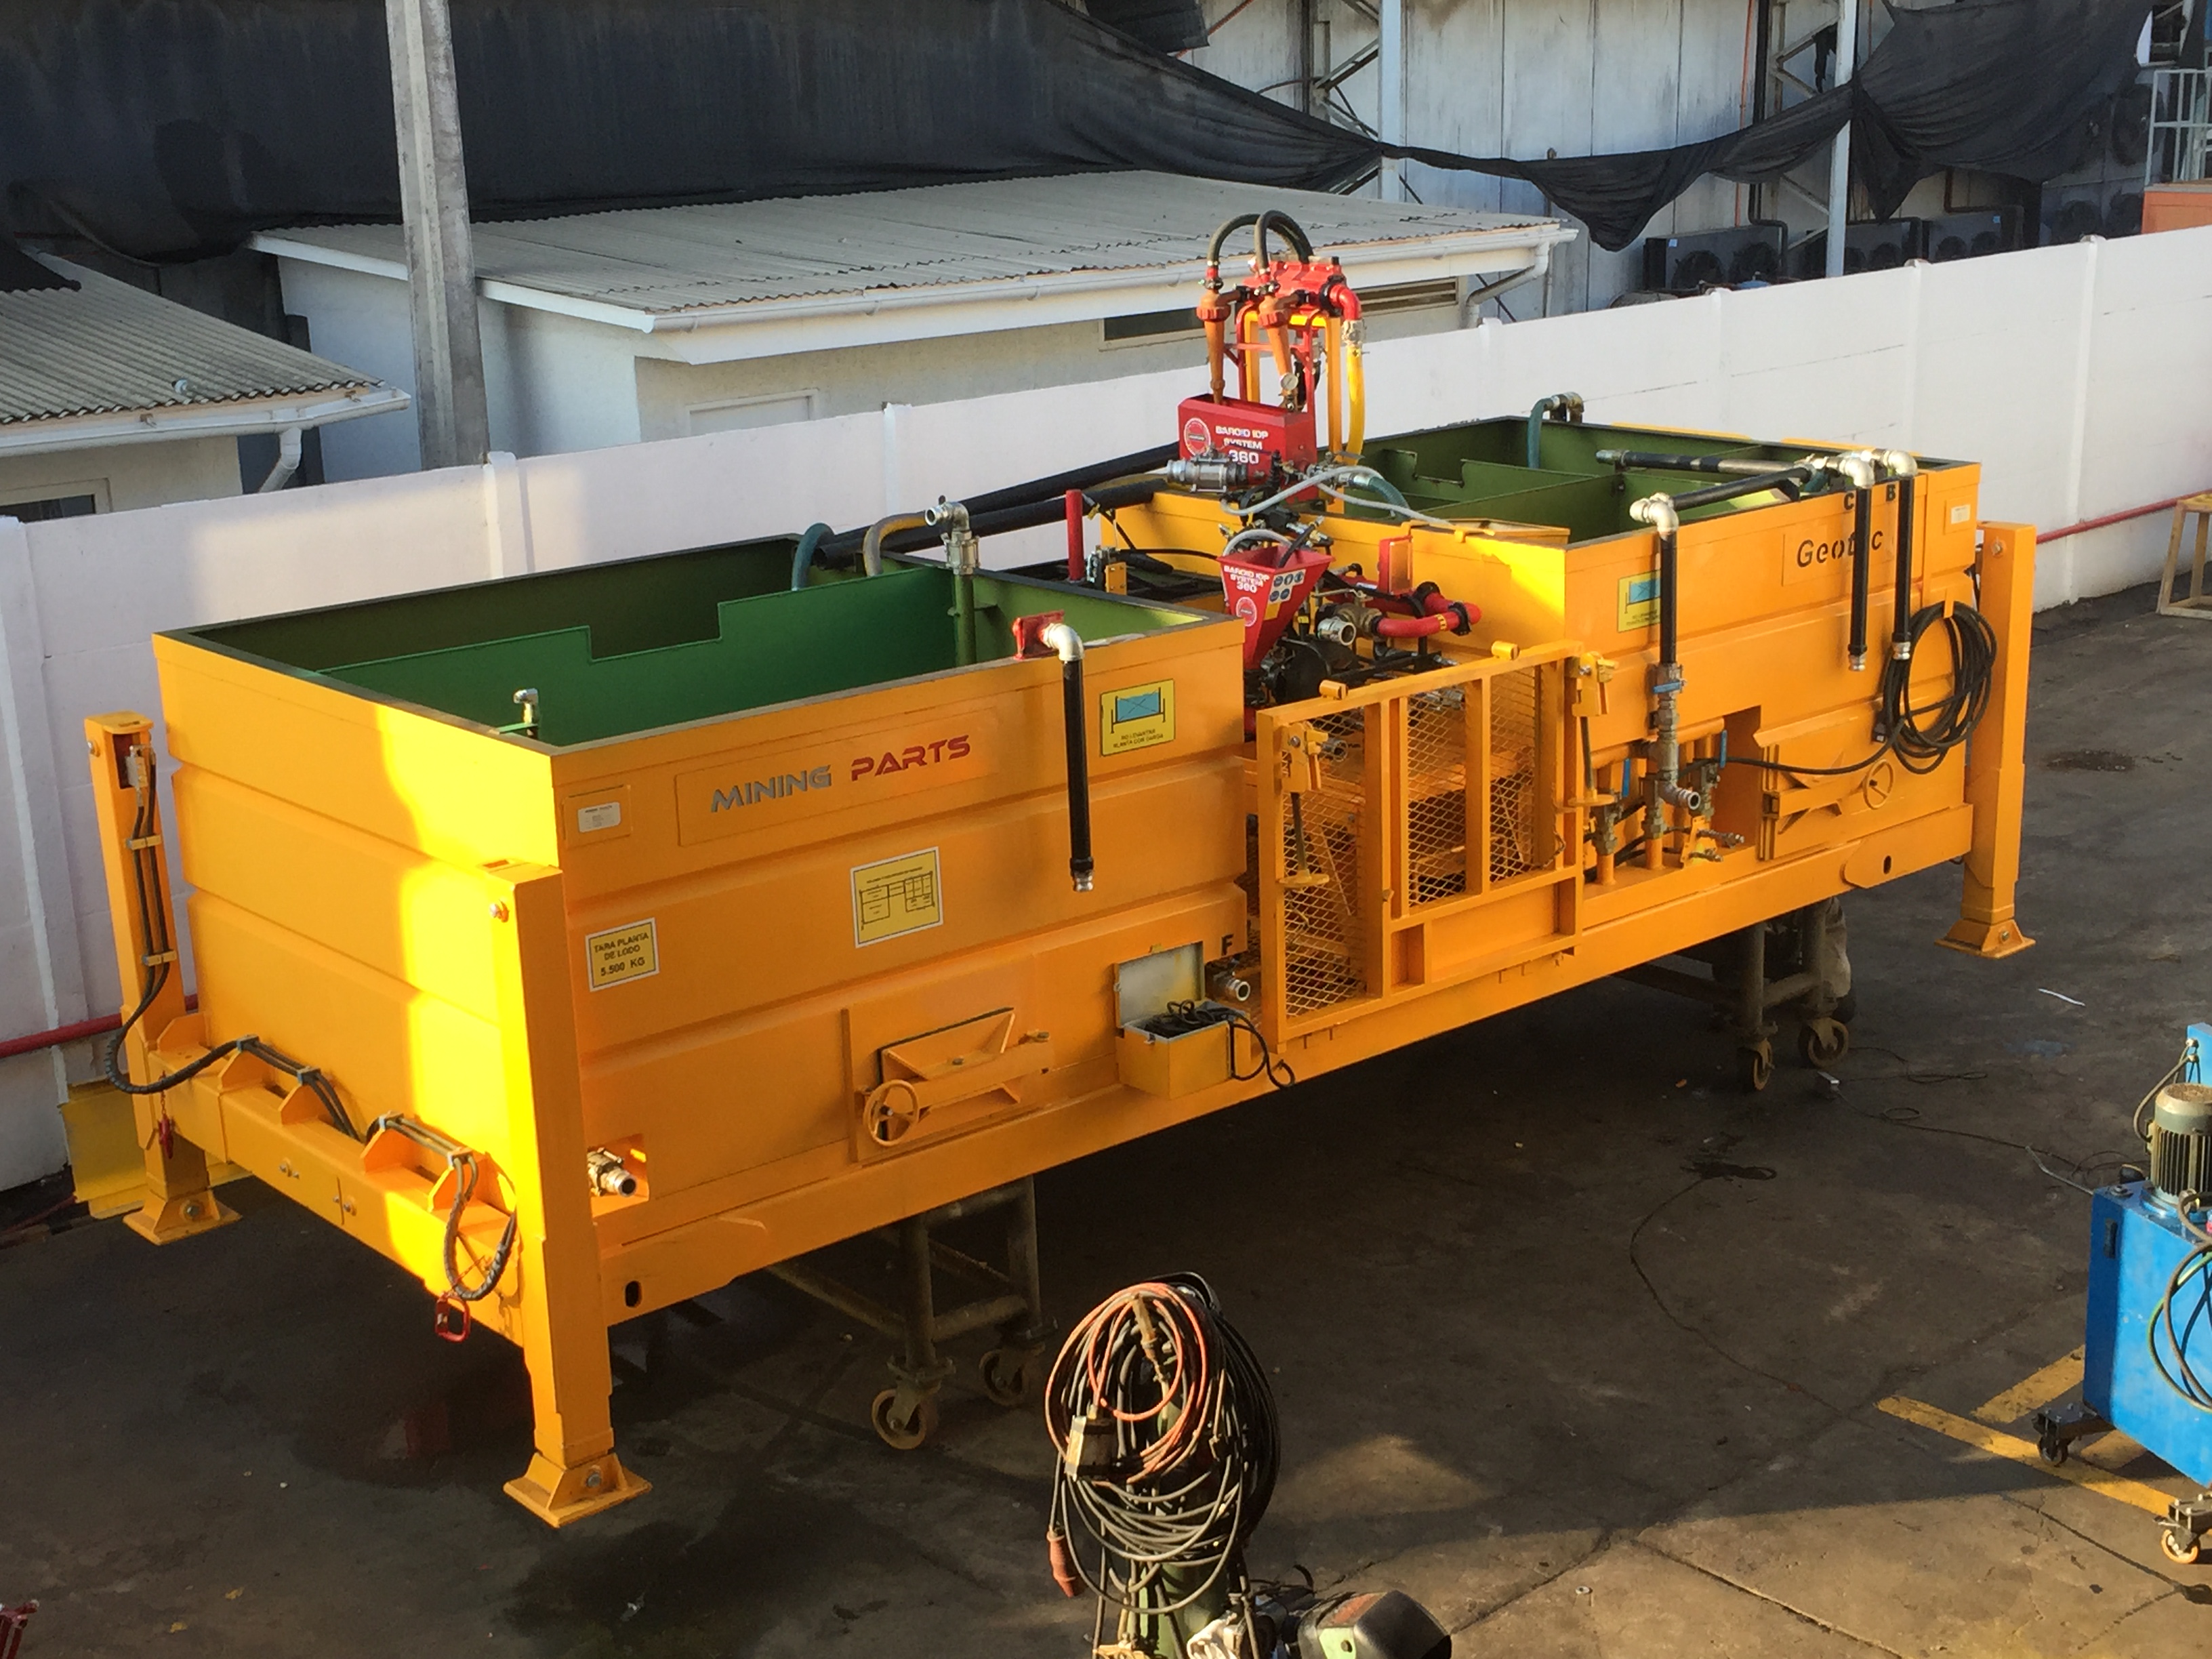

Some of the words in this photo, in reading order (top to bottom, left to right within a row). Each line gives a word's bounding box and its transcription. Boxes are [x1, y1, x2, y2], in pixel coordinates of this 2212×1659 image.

[1229, 450, 1258, 464] 360
[1844, 493, 1854, 510] C
[1886, 485, 1896, 502] B
[1797, 531, 1883, 568] Geotc
[711, 765, 832, 813] MINING
[851, 735, 971, 781] PARTS
[617, 933, 649, 947] PLANTA
[1222, 933, 1234, 956] F
[604, 951, 615, 960] DE
[617, 945, 640, 958] LODO
[600, 962, 626, 976] 5.500
[630, 957, 645, 968] KG
